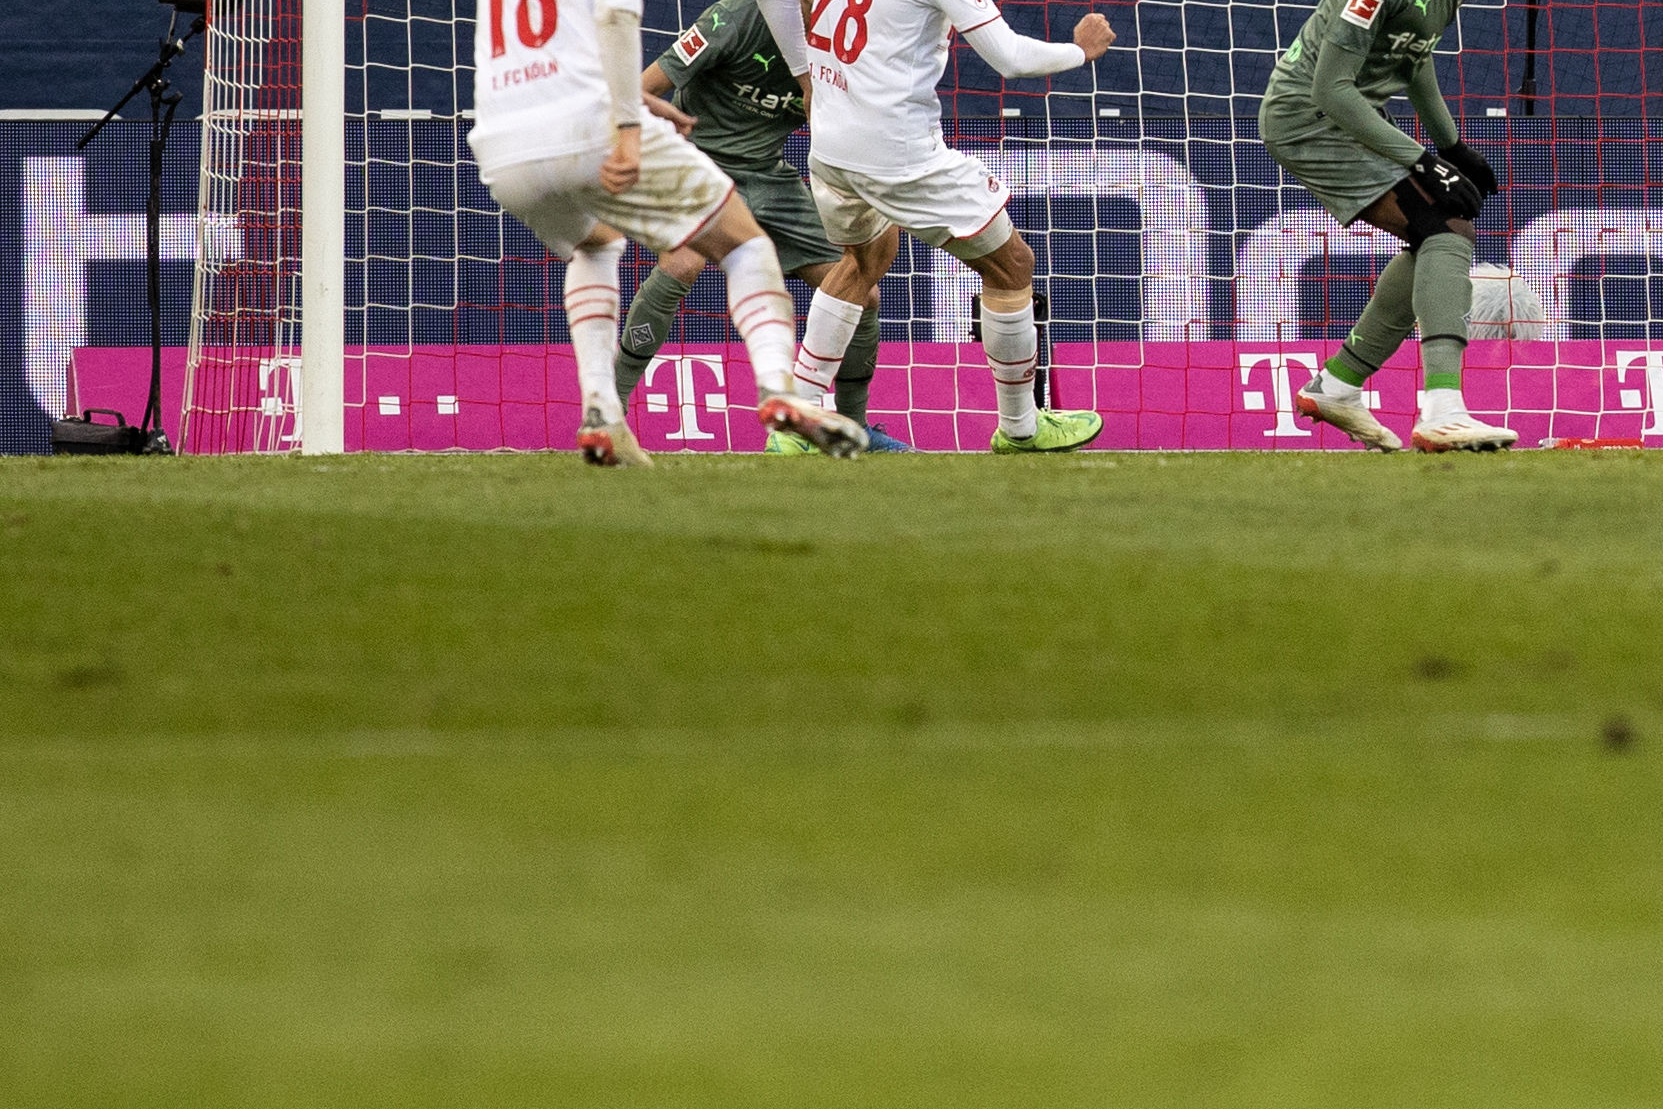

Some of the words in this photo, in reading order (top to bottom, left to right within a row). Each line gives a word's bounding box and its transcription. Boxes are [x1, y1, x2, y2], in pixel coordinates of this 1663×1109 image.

[1388, 32, 1442, 53] flat
[504, 68, 522, 87] FC
[524, 59, 559, 82] KÖLN
[820, 65, 832, 85] FC
